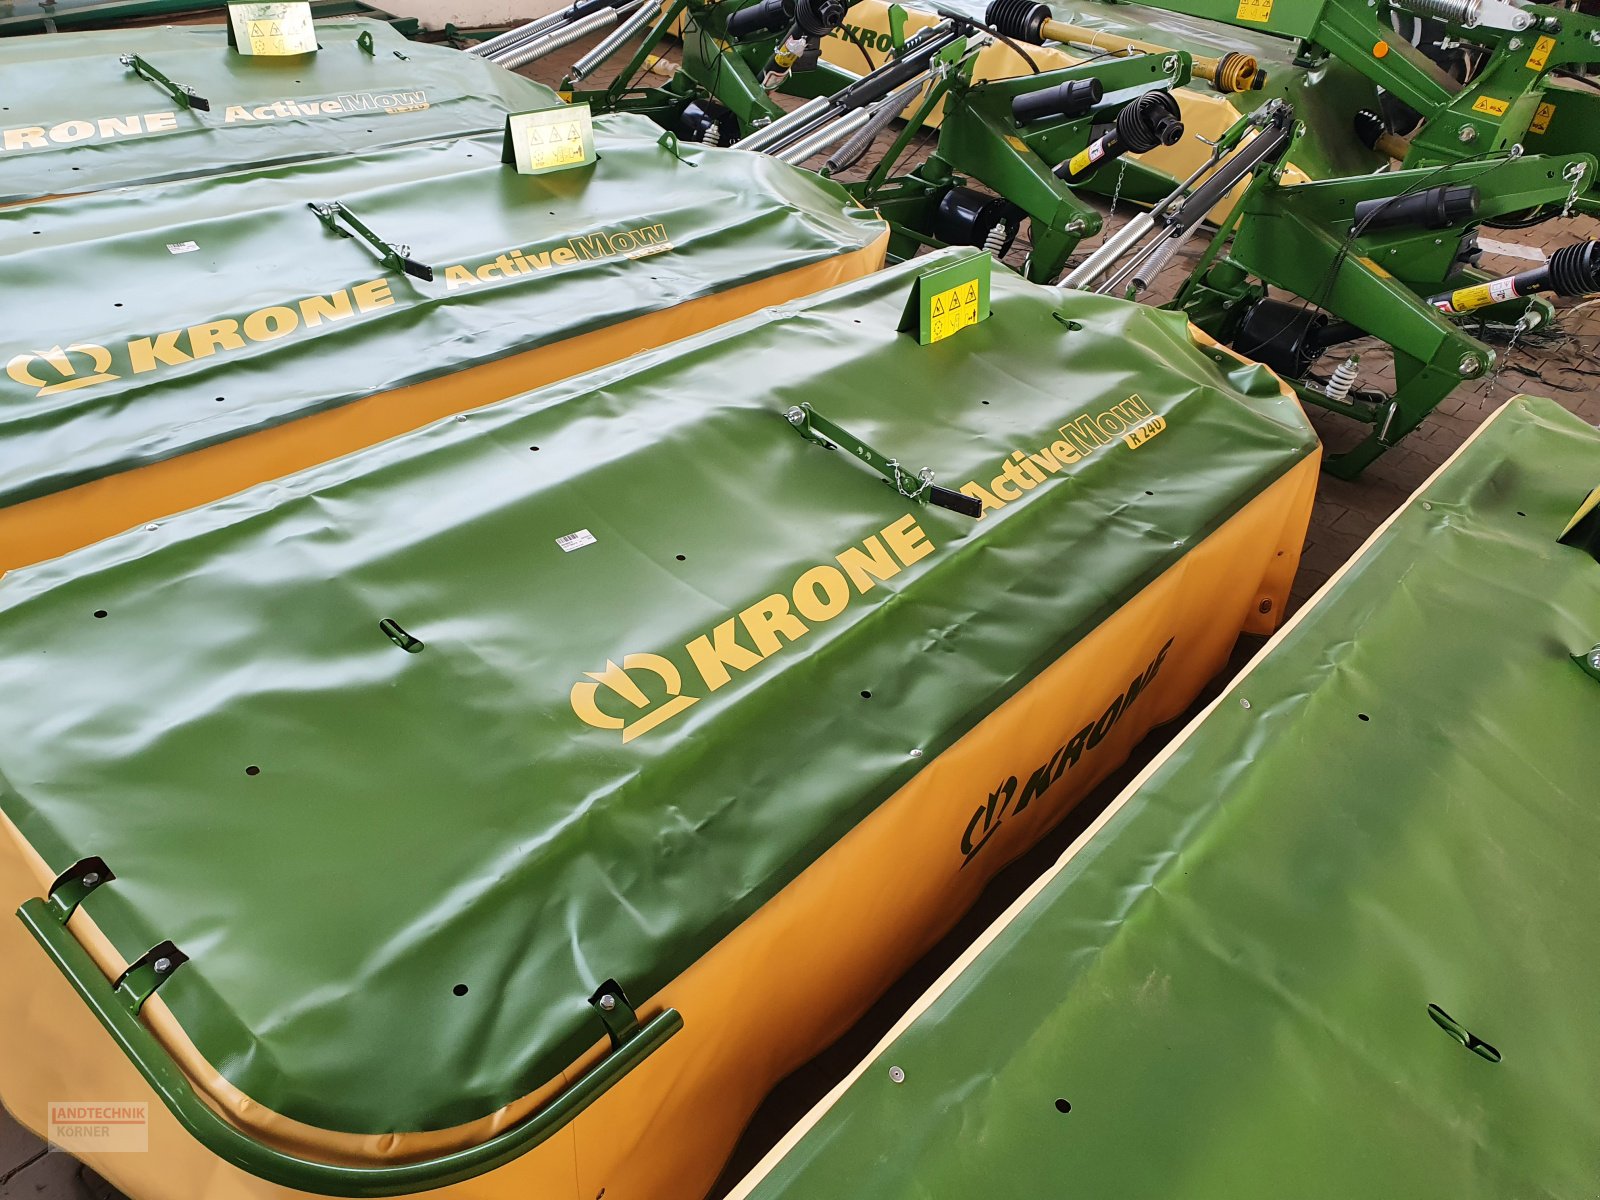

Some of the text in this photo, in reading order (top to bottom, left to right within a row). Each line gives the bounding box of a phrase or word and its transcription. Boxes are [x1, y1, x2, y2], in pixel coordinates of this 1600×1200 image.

[842, 24, 893, 52] KRO
[0, 112, 178, 151] RONE
[224, 91, 427, 123] ActiveMow
[444, 223, 669, 290] ActiveMow
[127, 277, 396, 375] KRONE
[959, 393, 1154, 522] ActiveMow
[1128, 418, 1162, 446] R 240
[686, 513, 936, 692] KRONE
[1011, 635, 1176, 818] KRONE
